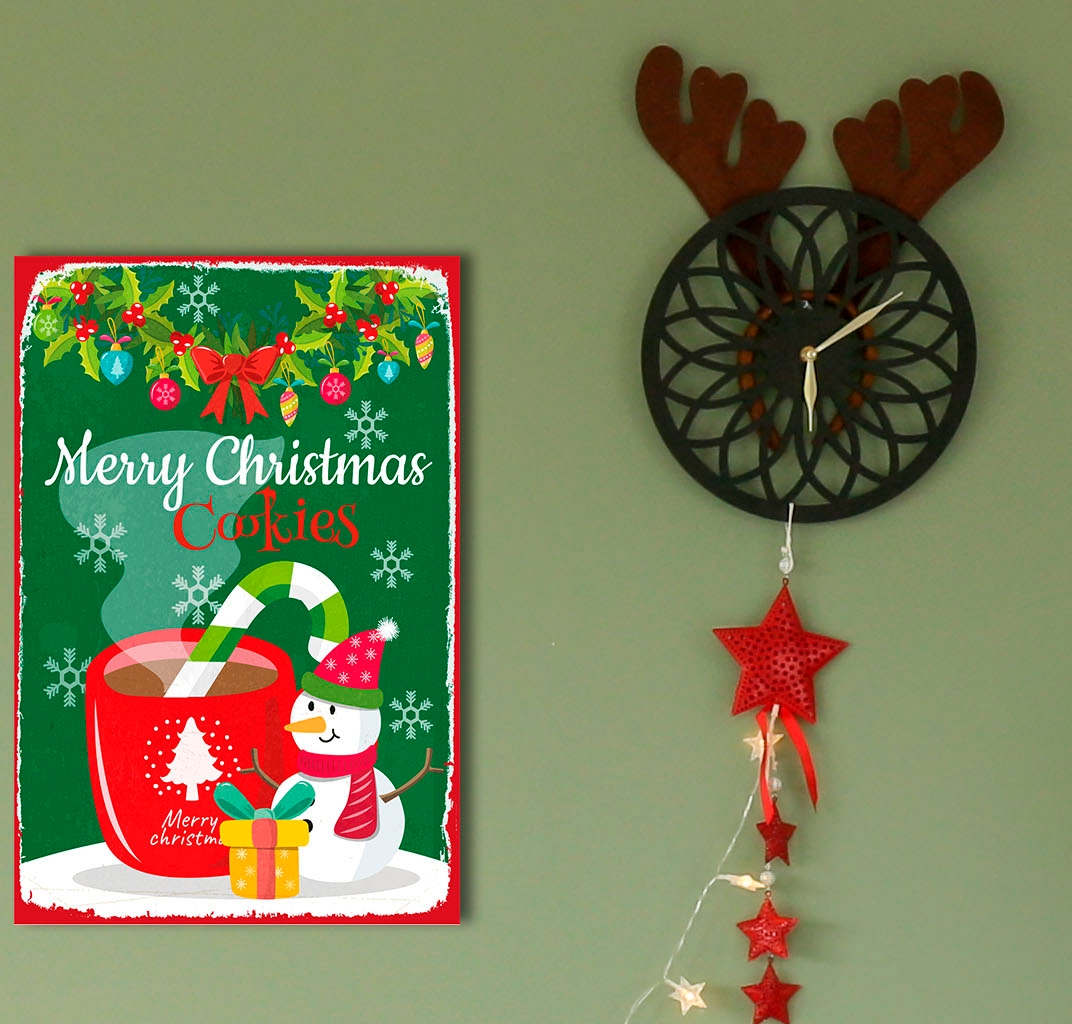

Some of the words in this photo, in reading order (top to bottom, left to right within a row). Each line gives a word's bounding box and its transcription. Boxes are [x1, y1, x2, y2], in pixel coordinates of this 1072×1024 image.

[44, 429, 194, 512] Merry
[206, 433, 433, 487] Christmas
[173, 486, 360, 553] Cookies
[161, 808, 219, 834] Merry
